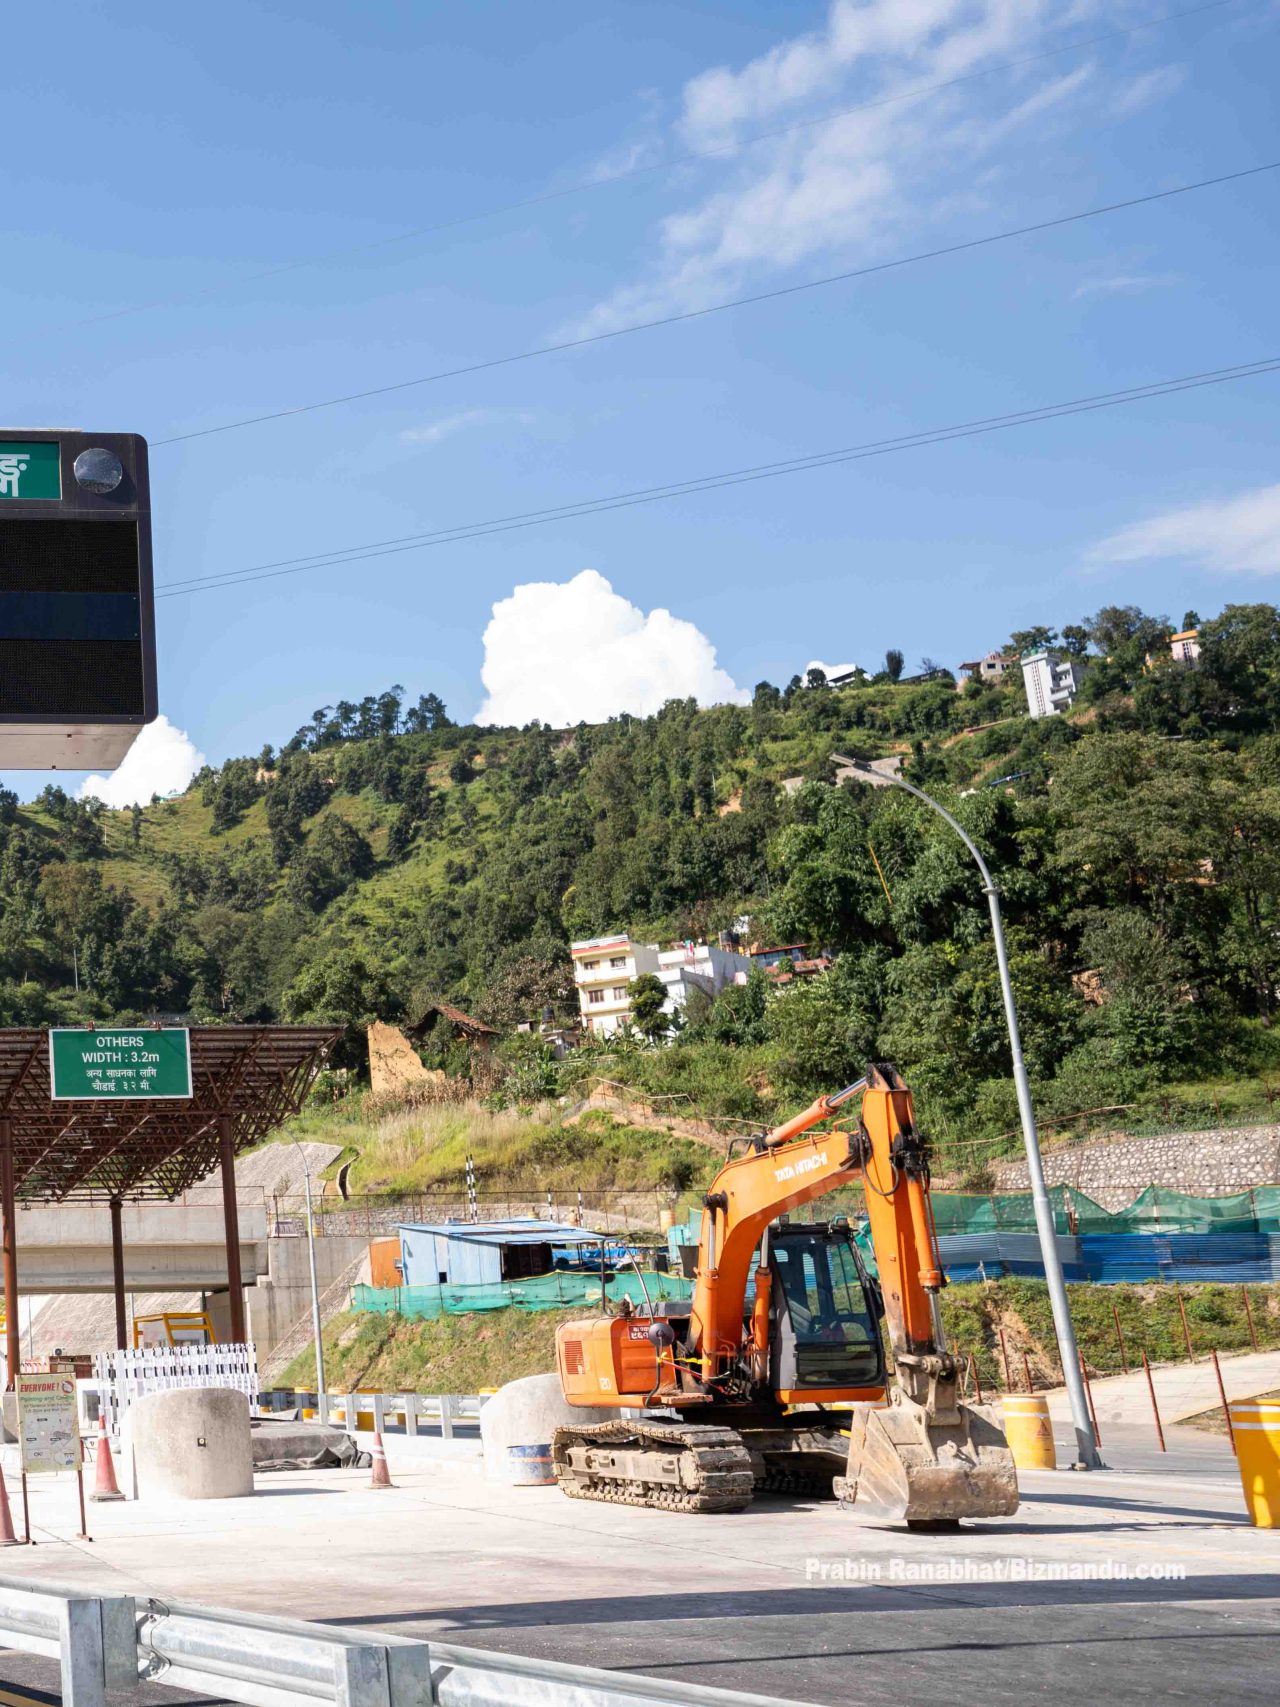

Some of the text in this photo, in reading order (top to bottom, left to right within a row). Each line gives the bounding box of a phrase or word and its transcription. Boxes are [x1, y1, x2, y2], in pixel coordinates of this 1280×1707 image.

[96, 1036, 144, 1047] OTHERS
[82, 1052, 121, 1063] WIDTH
[131, 1052, 160, 1063] 3.2m
[86, 1066, 157, 1078] अन्य साधनका लागि
[774, 1152, 829, 1183] TATA HITACHI
